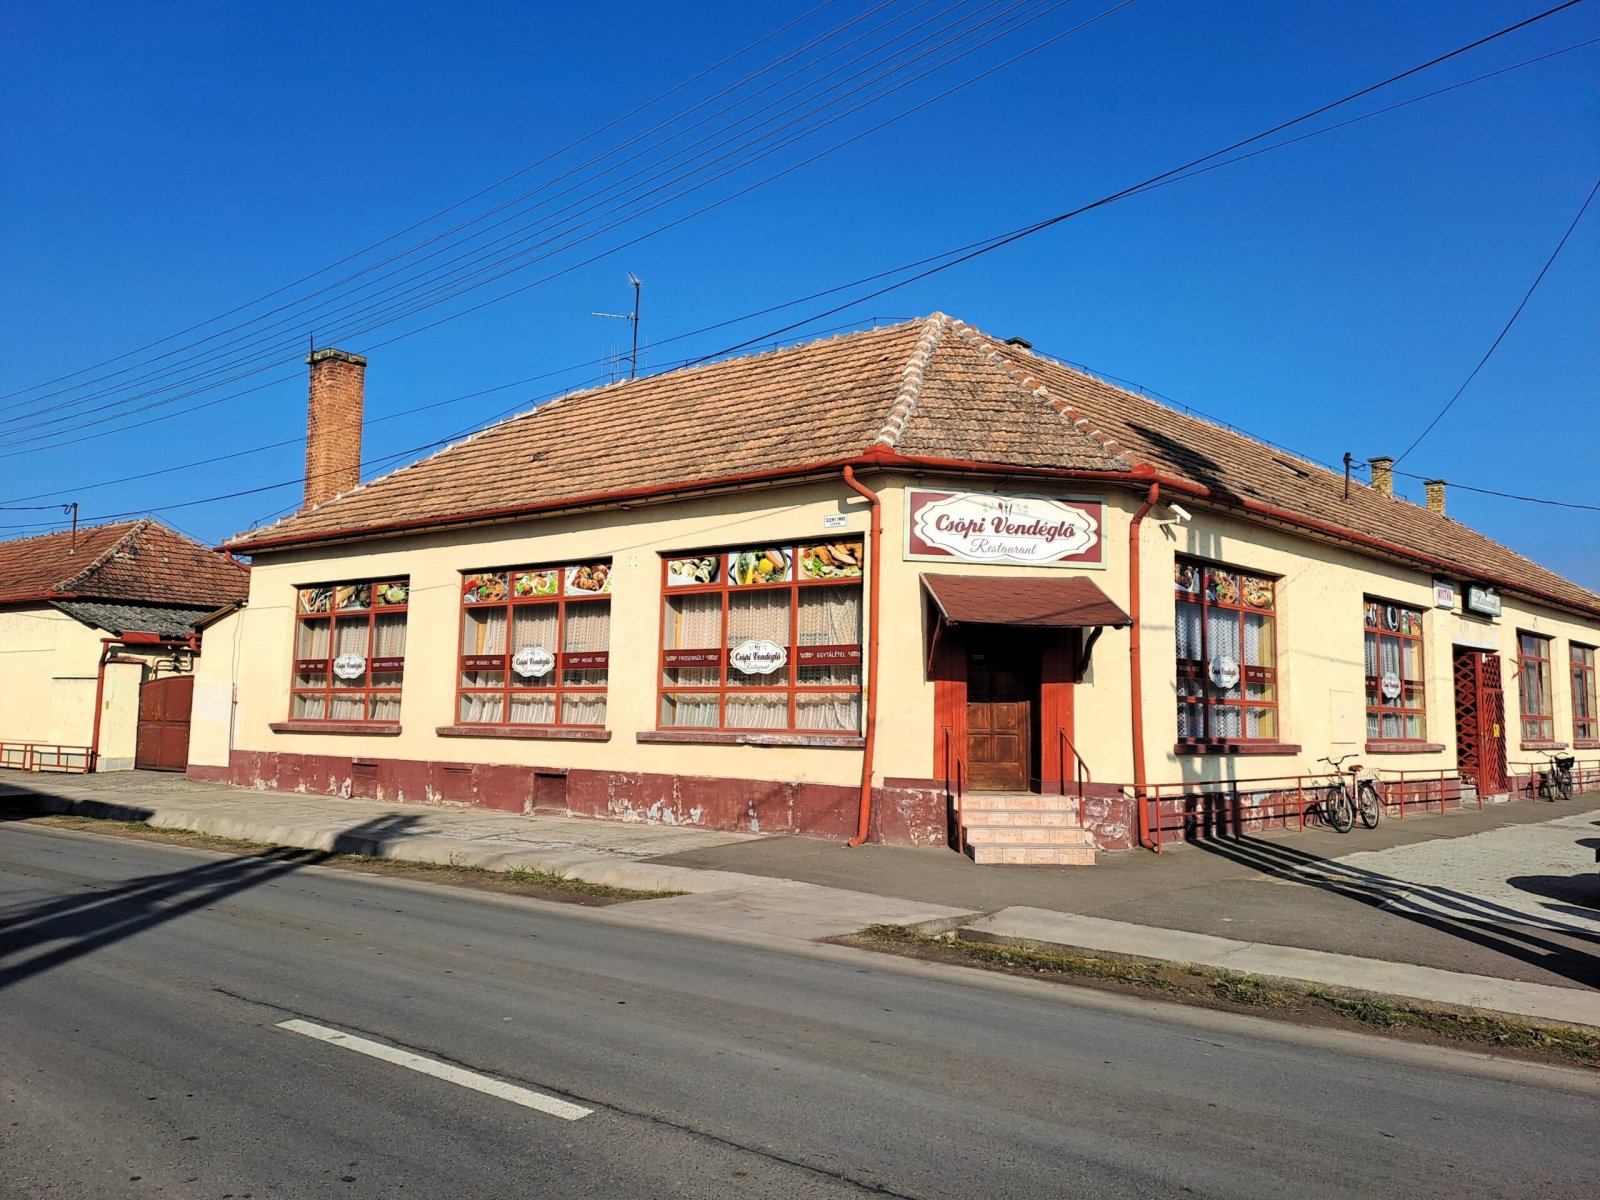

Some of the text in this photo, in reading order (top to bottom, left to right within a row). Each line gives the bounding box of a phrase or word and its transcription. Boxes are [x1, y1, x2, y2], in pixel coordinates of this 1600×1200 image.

[935, 514, 1076, 543] Csöpi Vendéglő
[969, 538, 1037, 556] Restaurant
[816, 651, 846, 659] EGYTÁLÉTEL
